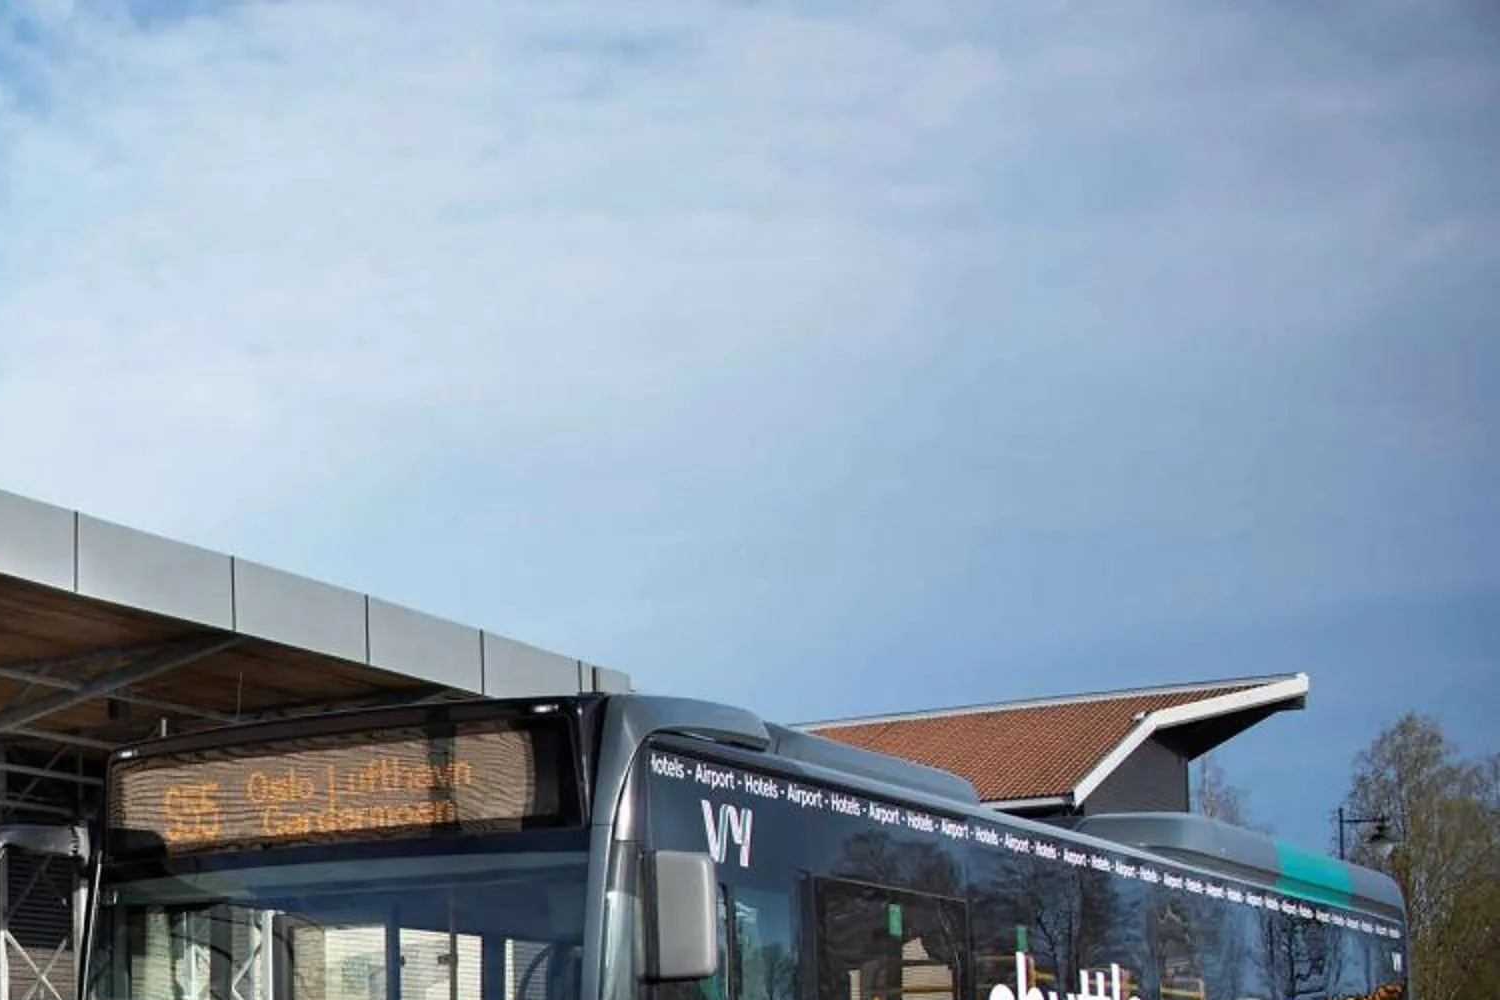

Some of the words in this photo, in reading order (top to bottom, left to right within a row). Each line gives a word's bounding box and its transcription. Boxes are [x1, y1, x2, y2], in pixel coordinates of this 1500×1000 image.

[246, 767, 314, 803] Oslo
[695, 763, 735, 790] Airport
[743, 773, 778, 799] Hotels
[787, 783, 823, 808] Airport
[830, 793, 861, 817] Hotels
[867, 801, 900, 826] Airport
[906, 810, 935, 833] Hotels
